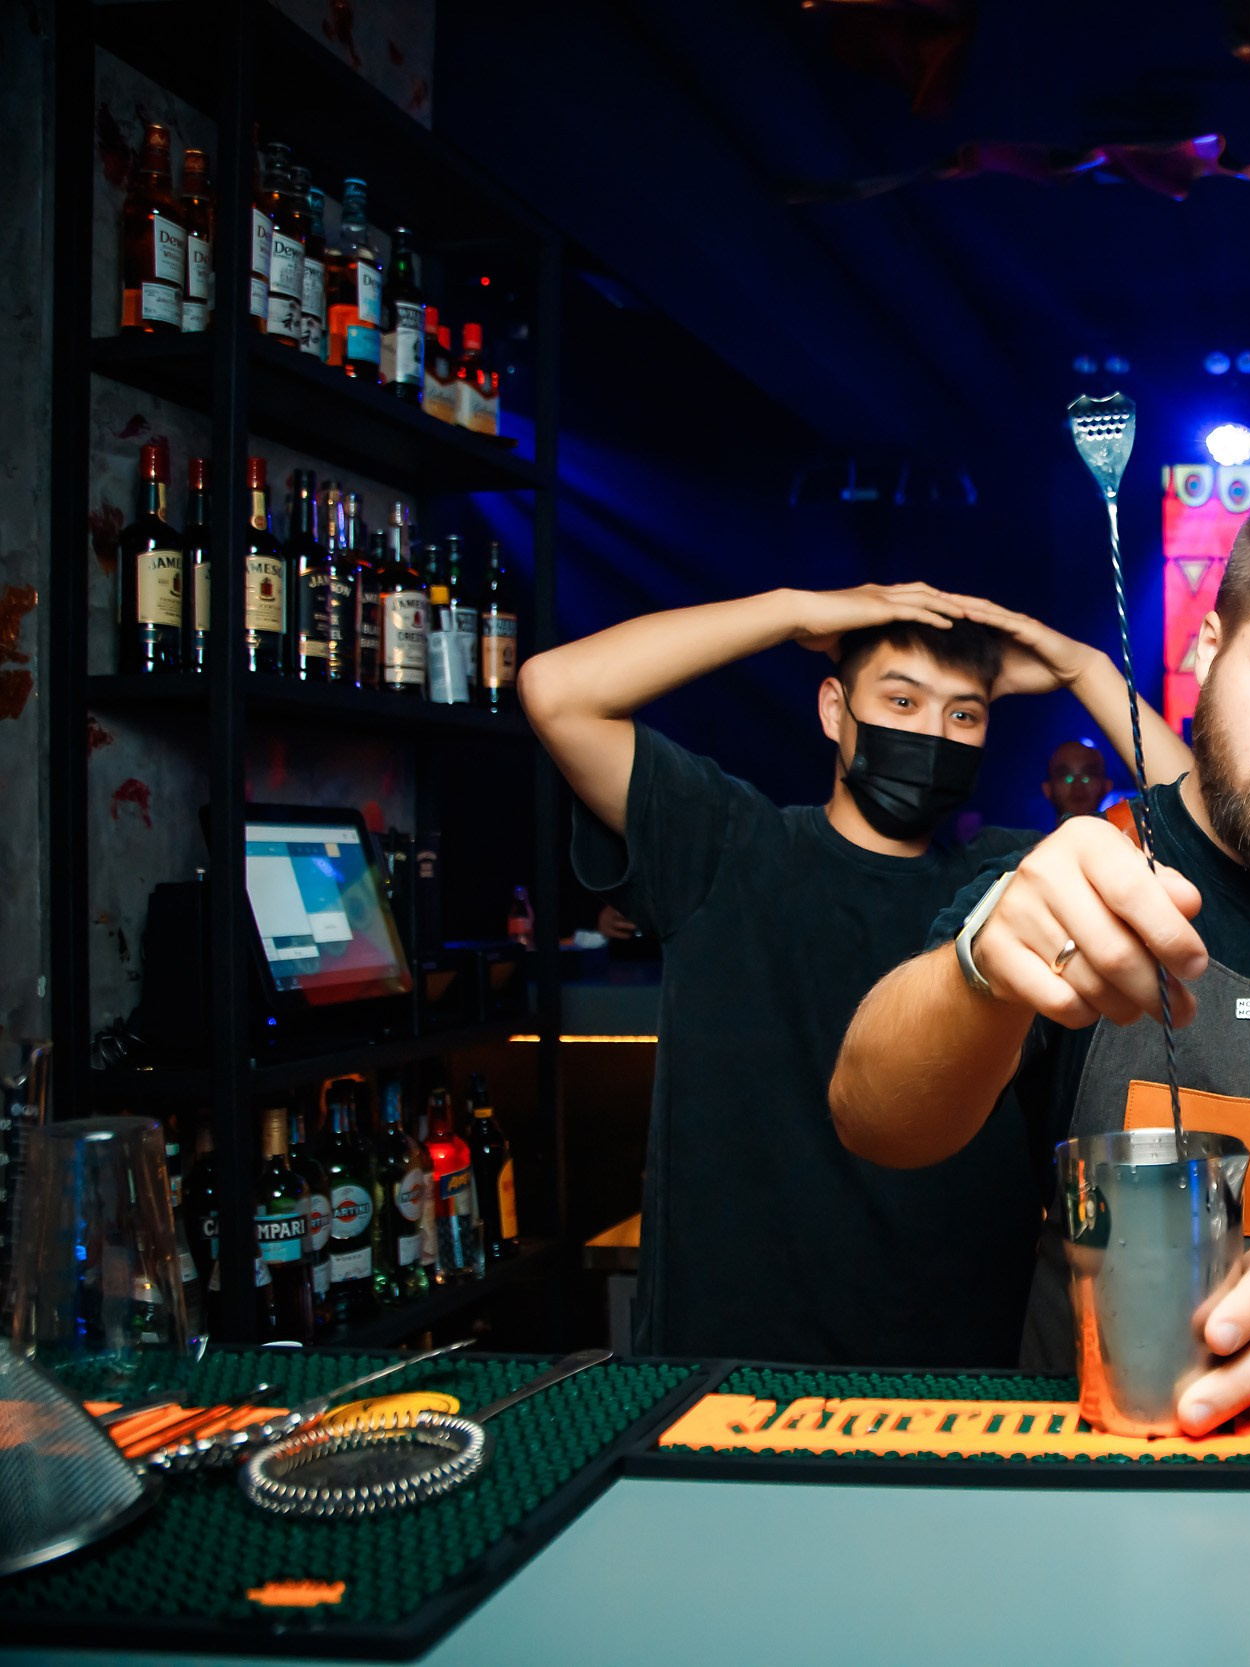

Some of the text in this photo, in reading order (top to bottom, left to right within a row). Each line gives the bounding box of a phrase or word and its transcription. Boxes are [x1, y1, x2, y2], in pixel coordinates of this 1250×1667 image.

[148, 556, 182, 571] JAME
[333, 1203, 370, 1218] ARTINI
[257, 1219, 306, 1241] MPARI
